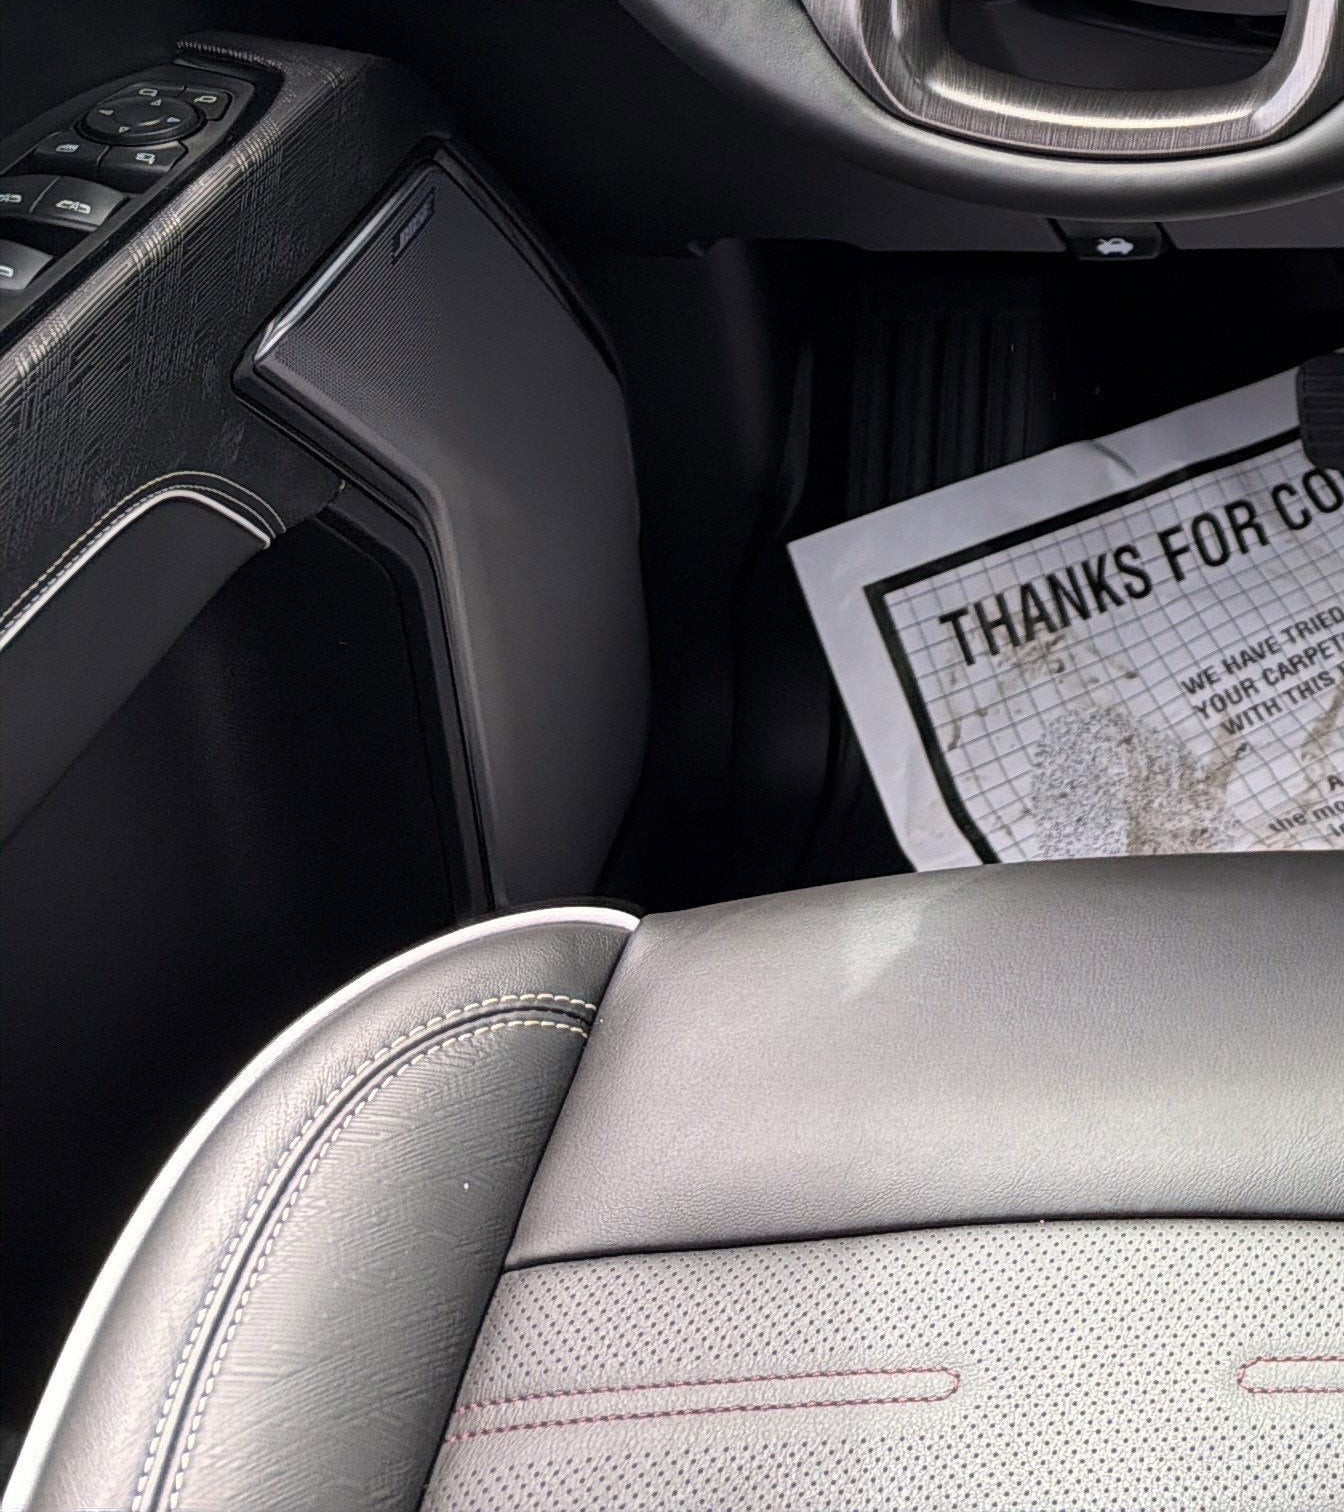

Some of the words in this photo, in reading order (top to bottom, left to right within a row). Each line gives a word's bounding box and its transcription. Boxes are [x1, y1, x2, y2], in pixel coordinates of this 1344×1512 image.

[938, 545, 1154, 668] THANKS
[1156, 496, 1269, 584] FOR
[1180, 664, 1222, 696] WE
[1221, 637, 1283, 676] HAVE
[1193, 677, 1260, 721] YOUR
[1220, 698, 1284, 737] WITH
[1283, 669, 1337, 707] THIS
[1268, 807, 1309, 834] the
